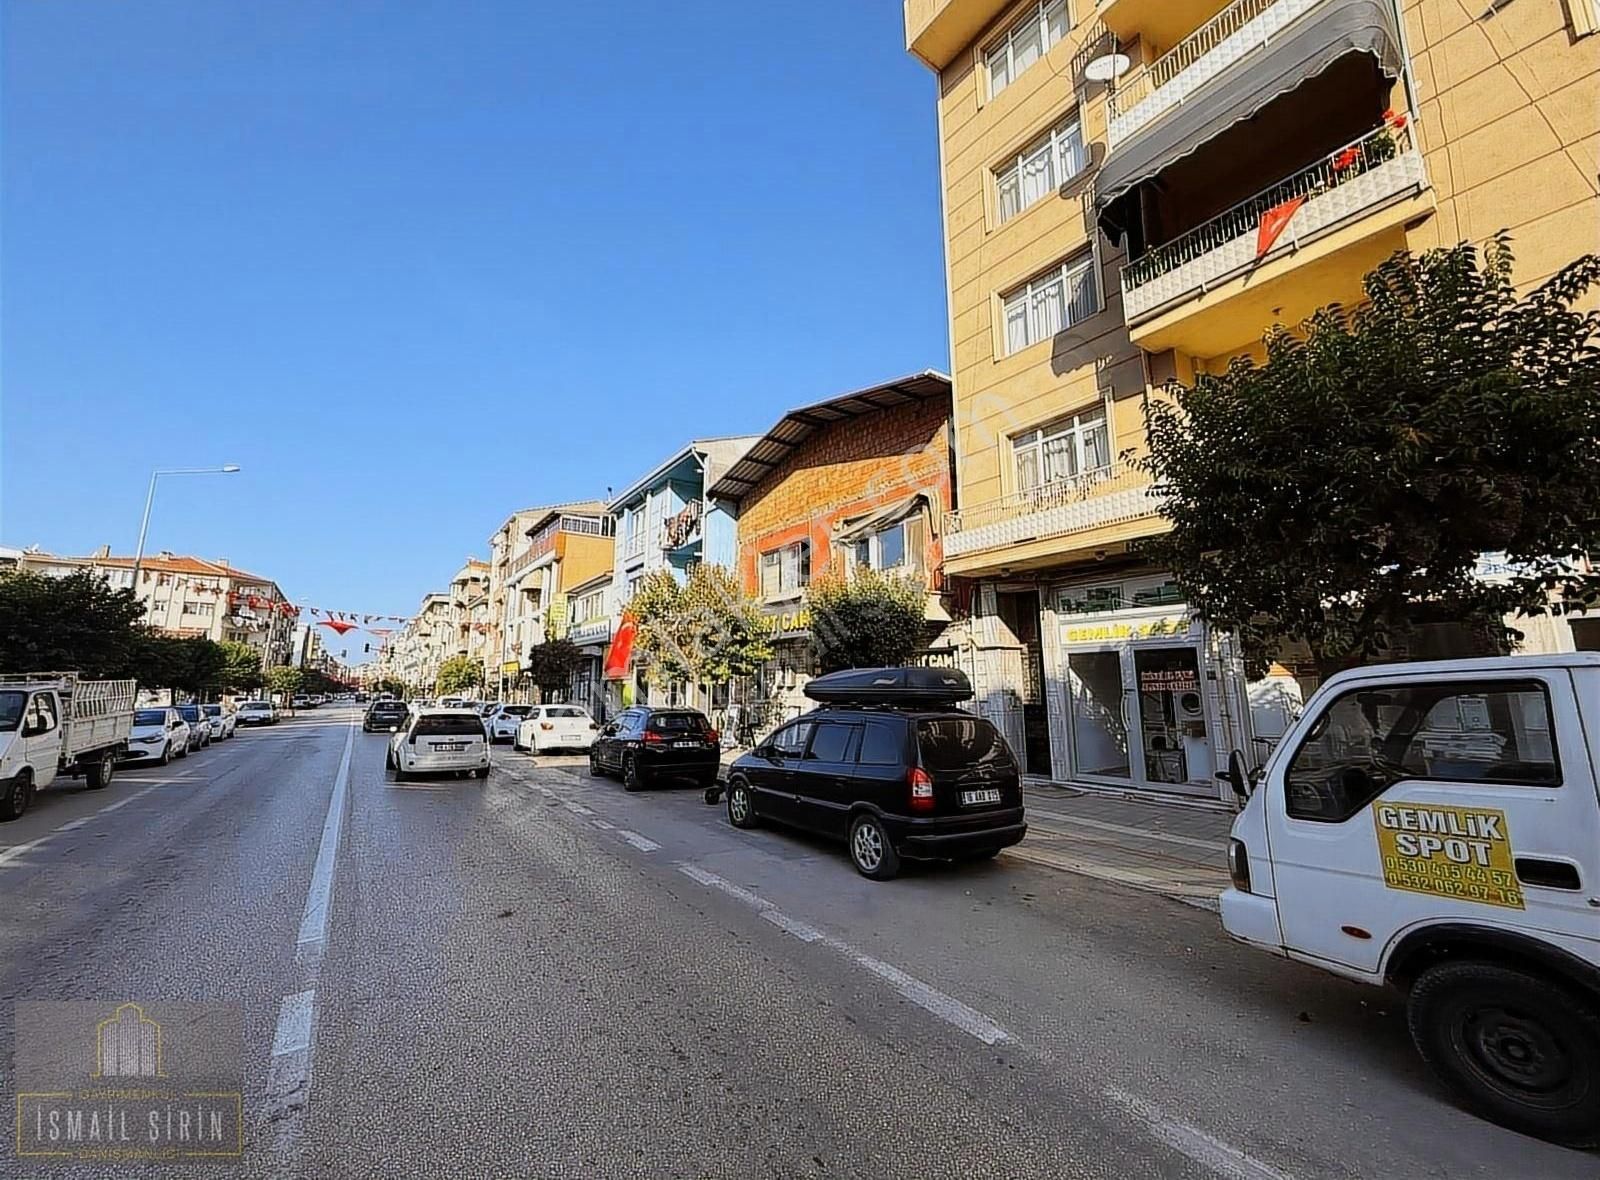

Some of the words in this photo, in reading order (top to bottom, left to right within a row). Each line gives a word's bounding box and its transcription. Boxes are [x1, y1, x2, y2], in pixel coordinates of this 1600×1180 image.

[929, 654, 953, 668] CAM
[1395, 832, 1492, 868] SPOT
[1386, 856, 1395, 869] 0
[1399, 857, 1427, 874] 530
[1431, 861, 1461, 879] 415
[1465, 866, 1487, 883] 44
[1491, 871, 1513, 886] 57
[1388, 872, 1398, 885] 0
[1402, 873, 1430, 890] 532
[1434, 879, 1465, 896] 062
[1469, 884, 1490, 900] 97
